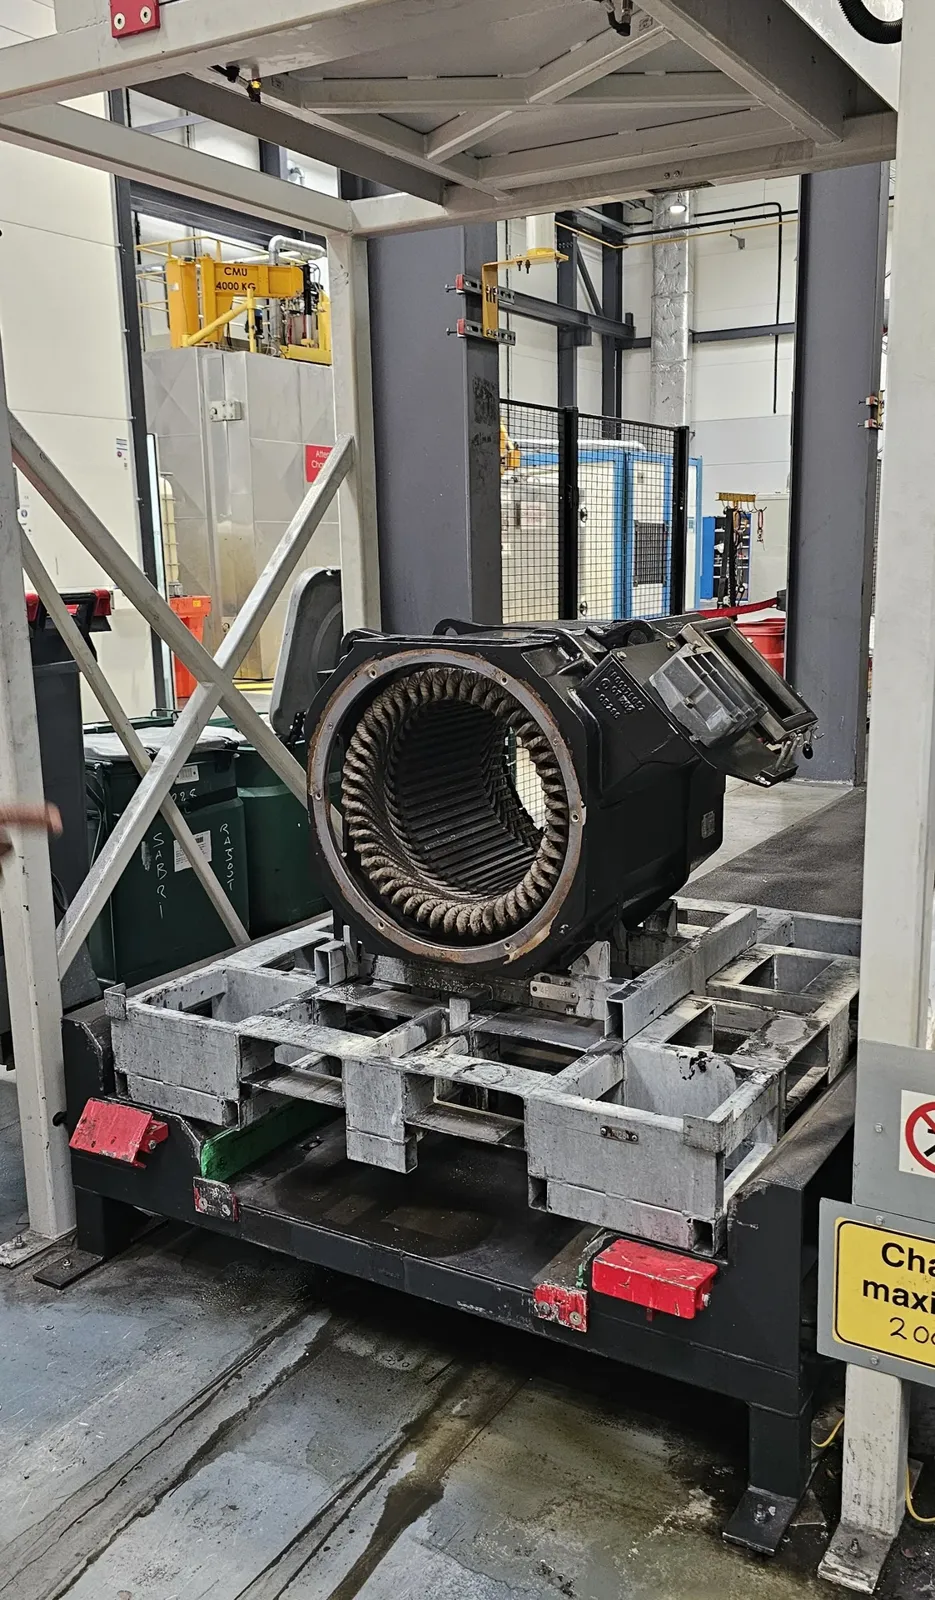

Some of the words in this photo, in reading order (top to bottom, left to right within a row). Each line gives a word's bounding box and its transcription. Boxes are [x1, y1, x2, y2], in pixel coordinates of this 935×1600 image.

[224, 266, 248, 276] CMU
[215, 281, 239, 291] 4000
[241, 282, 256, 291] KG
[889, 1317, 935, 1345] 20
